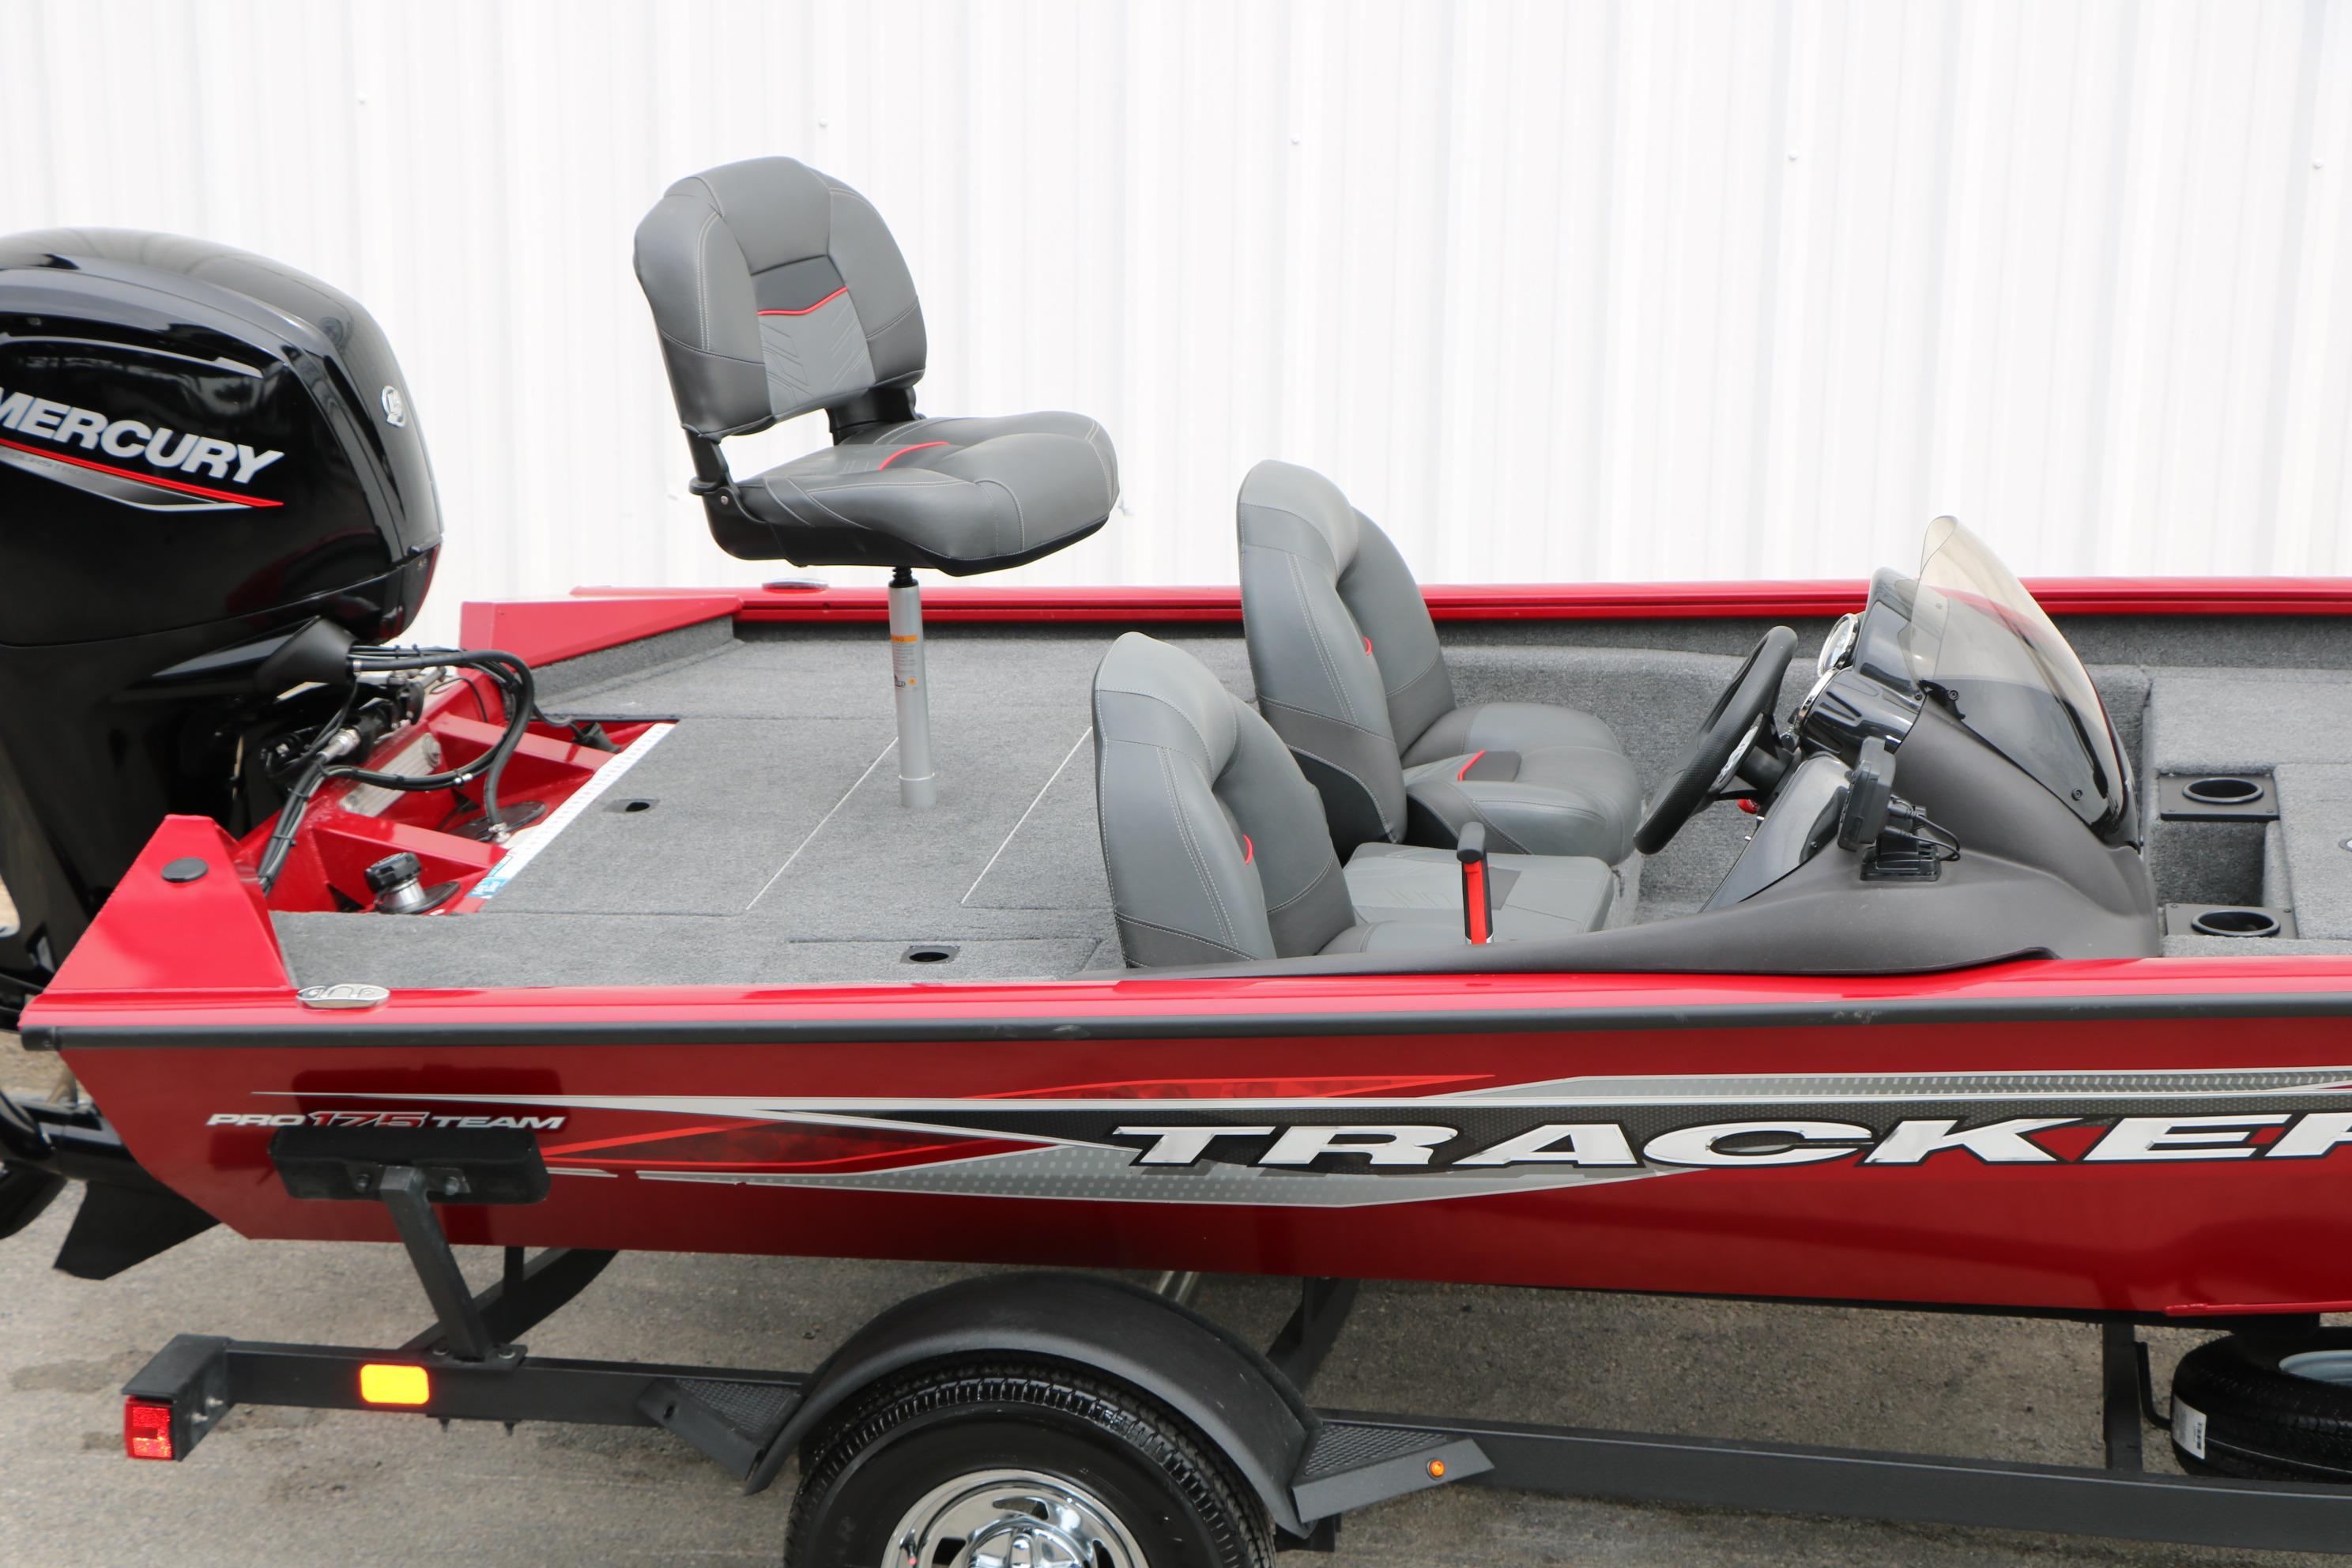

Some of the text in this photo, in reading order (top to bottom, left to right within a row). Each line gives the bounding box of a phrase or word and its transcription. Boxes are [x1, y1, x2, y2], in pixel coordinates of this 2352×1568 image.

[206, 1110, 566, 1129] PRO 175 TEAM
